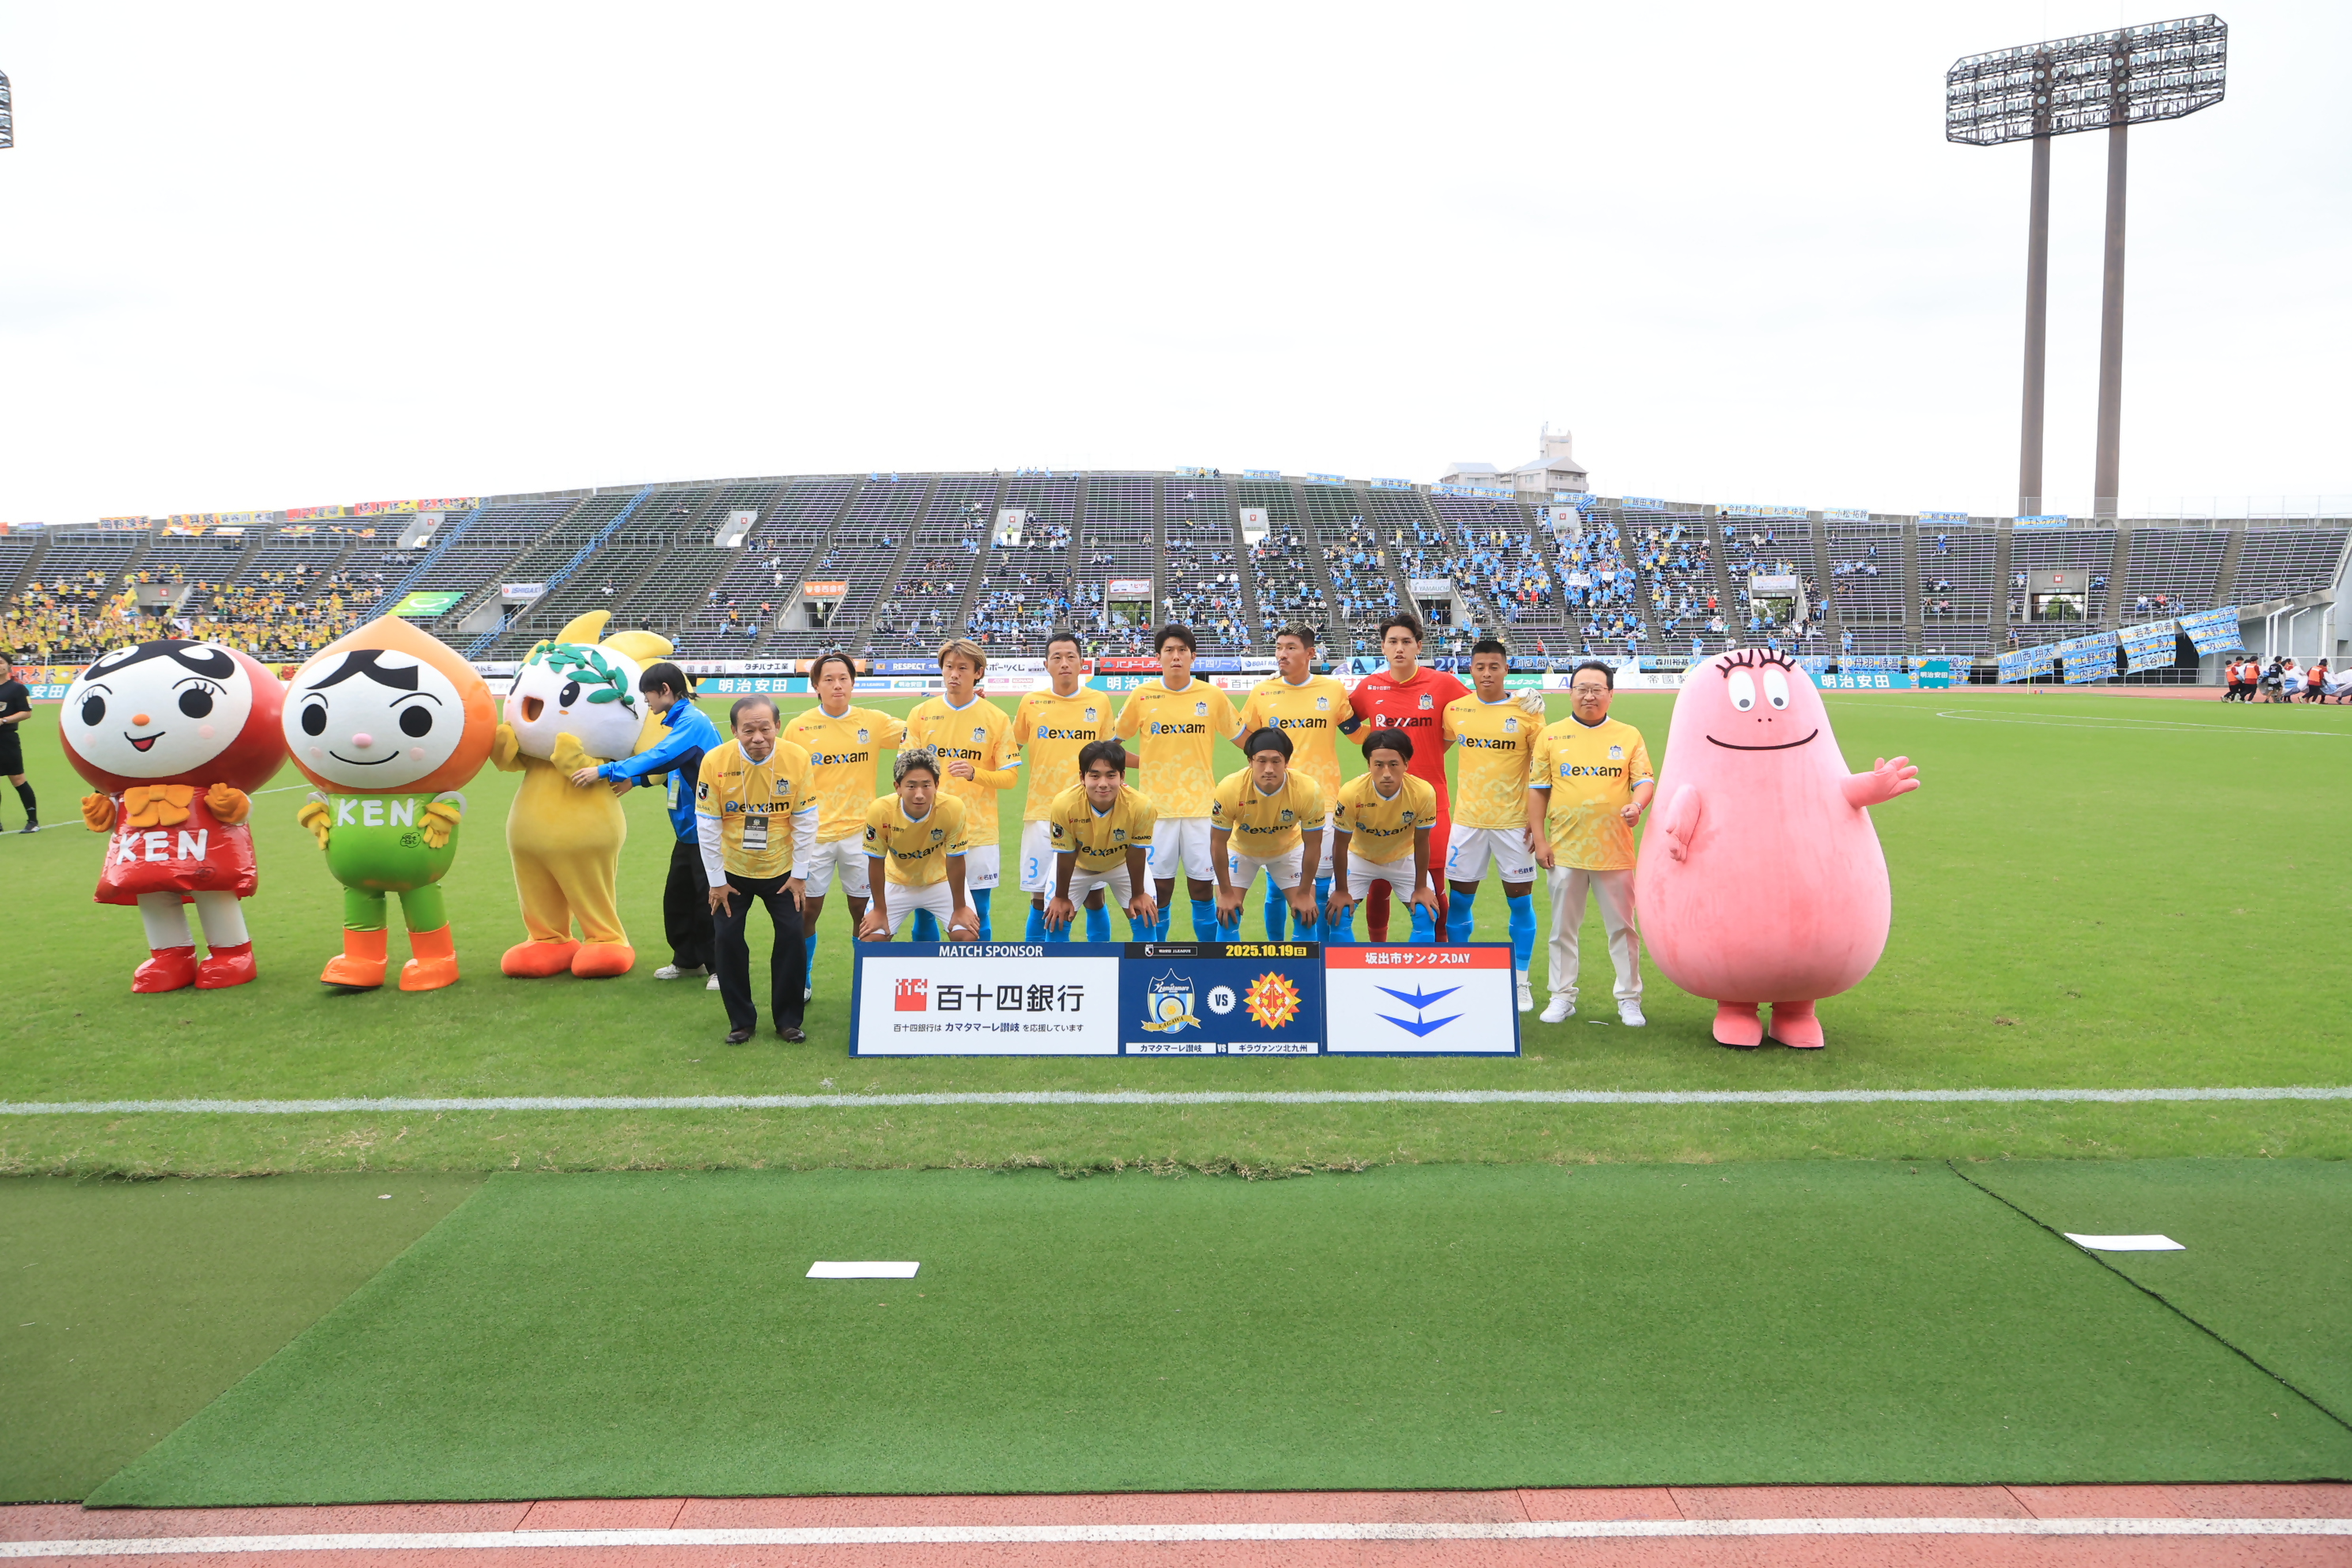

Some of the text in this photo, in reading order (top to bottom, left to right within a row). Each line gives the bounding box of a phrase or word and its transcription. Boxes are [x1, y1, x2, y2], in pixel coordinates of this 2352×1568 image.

[1728, 505, 1758, 514] 今村 勇介
[1775, 507, 1788, 516] 松原
[1835, 510, 1850, 518] 小松
[1932, 513, 1939, 522] 柳
[1943, 514, 1968, 522] 雄太郎
[2180, 616, 2195, 627] 33
[2135, 625, 2152, 639] 岩本
[2155, 621, 2173, 633] 和希
[2189, 629, 2201, 640] 22
[2202, 626, 2219, 638] 大野
[2060, 642, 2074, 653] 60
[2075, 638, 2094, 650] 森川
[2138, 642, 2147, 653] 森
[2156, 637, 2173, 650] 勇人
[1517, 659, 1534, 669] 川西
[1854, 657, 1875, 669] 丹羽
[1878, 657, 1899, 669] 詩温
[1949, 657, 1970, 669] 優介
[2000, 654, 2012, 666] 10
[2014, 650, 2031, 663] 川西
[2063, 657, 2076, 669] 24
[2079, 652, 2096, 666] 上野
[2140, 653, 2165, 669] 長谷川
[684, 665, 722, 673] 国興業
[2000, 669, 2012, 681] 13
[1821, 675, 1890, 688] 明治安田
[2068, 671, 2076, 682] 2
[30, 685, 66, 699] 安田
[718, 678, 788, 693] 明治安田
[1268, 716, 1327, 729] Rexxam
[1375, 712, 1430, 726] Rexxam
[1038, 726, 1096, 741] Rexxam
[1151, 721, 1205, 735] Rexxam
[1457, 733, 1514, 748] Rexxam
[810, 752, 869, 766] Rexxam
[925, 744, 982, 761] Rexxam
[1559, 762, 1623, 777] Rexxam
[337, 797, 414, 827] KEN
[725, 800, 790, 814] Rexxam
[116, 828, 208, 865] KEN
[1448, 845, 1459, 868] 2
[1028, 857, 1038, 878] 3
[939, 945, 1043, 957] MATCH SPONSOR
[1366, 952, 1471, 965] 坂出市サンクスDAY
[936, 983, 1084, 1012] 百十四銀行
[1215, 993, 1228, 1006] VS
[894, 1022, 1084, 1033] 百十四銀行は カマタマーレ讃岐 を応援しています
[1158, 1016, 1185, 1030] KAGAWA
[1140, 1044, 1202, 1053] カマタマーレ讃岐
[1217, 1043, 1227, 1053] VS
[1238, 1043, 1308, 1053] ギラヴァンツ北九州
